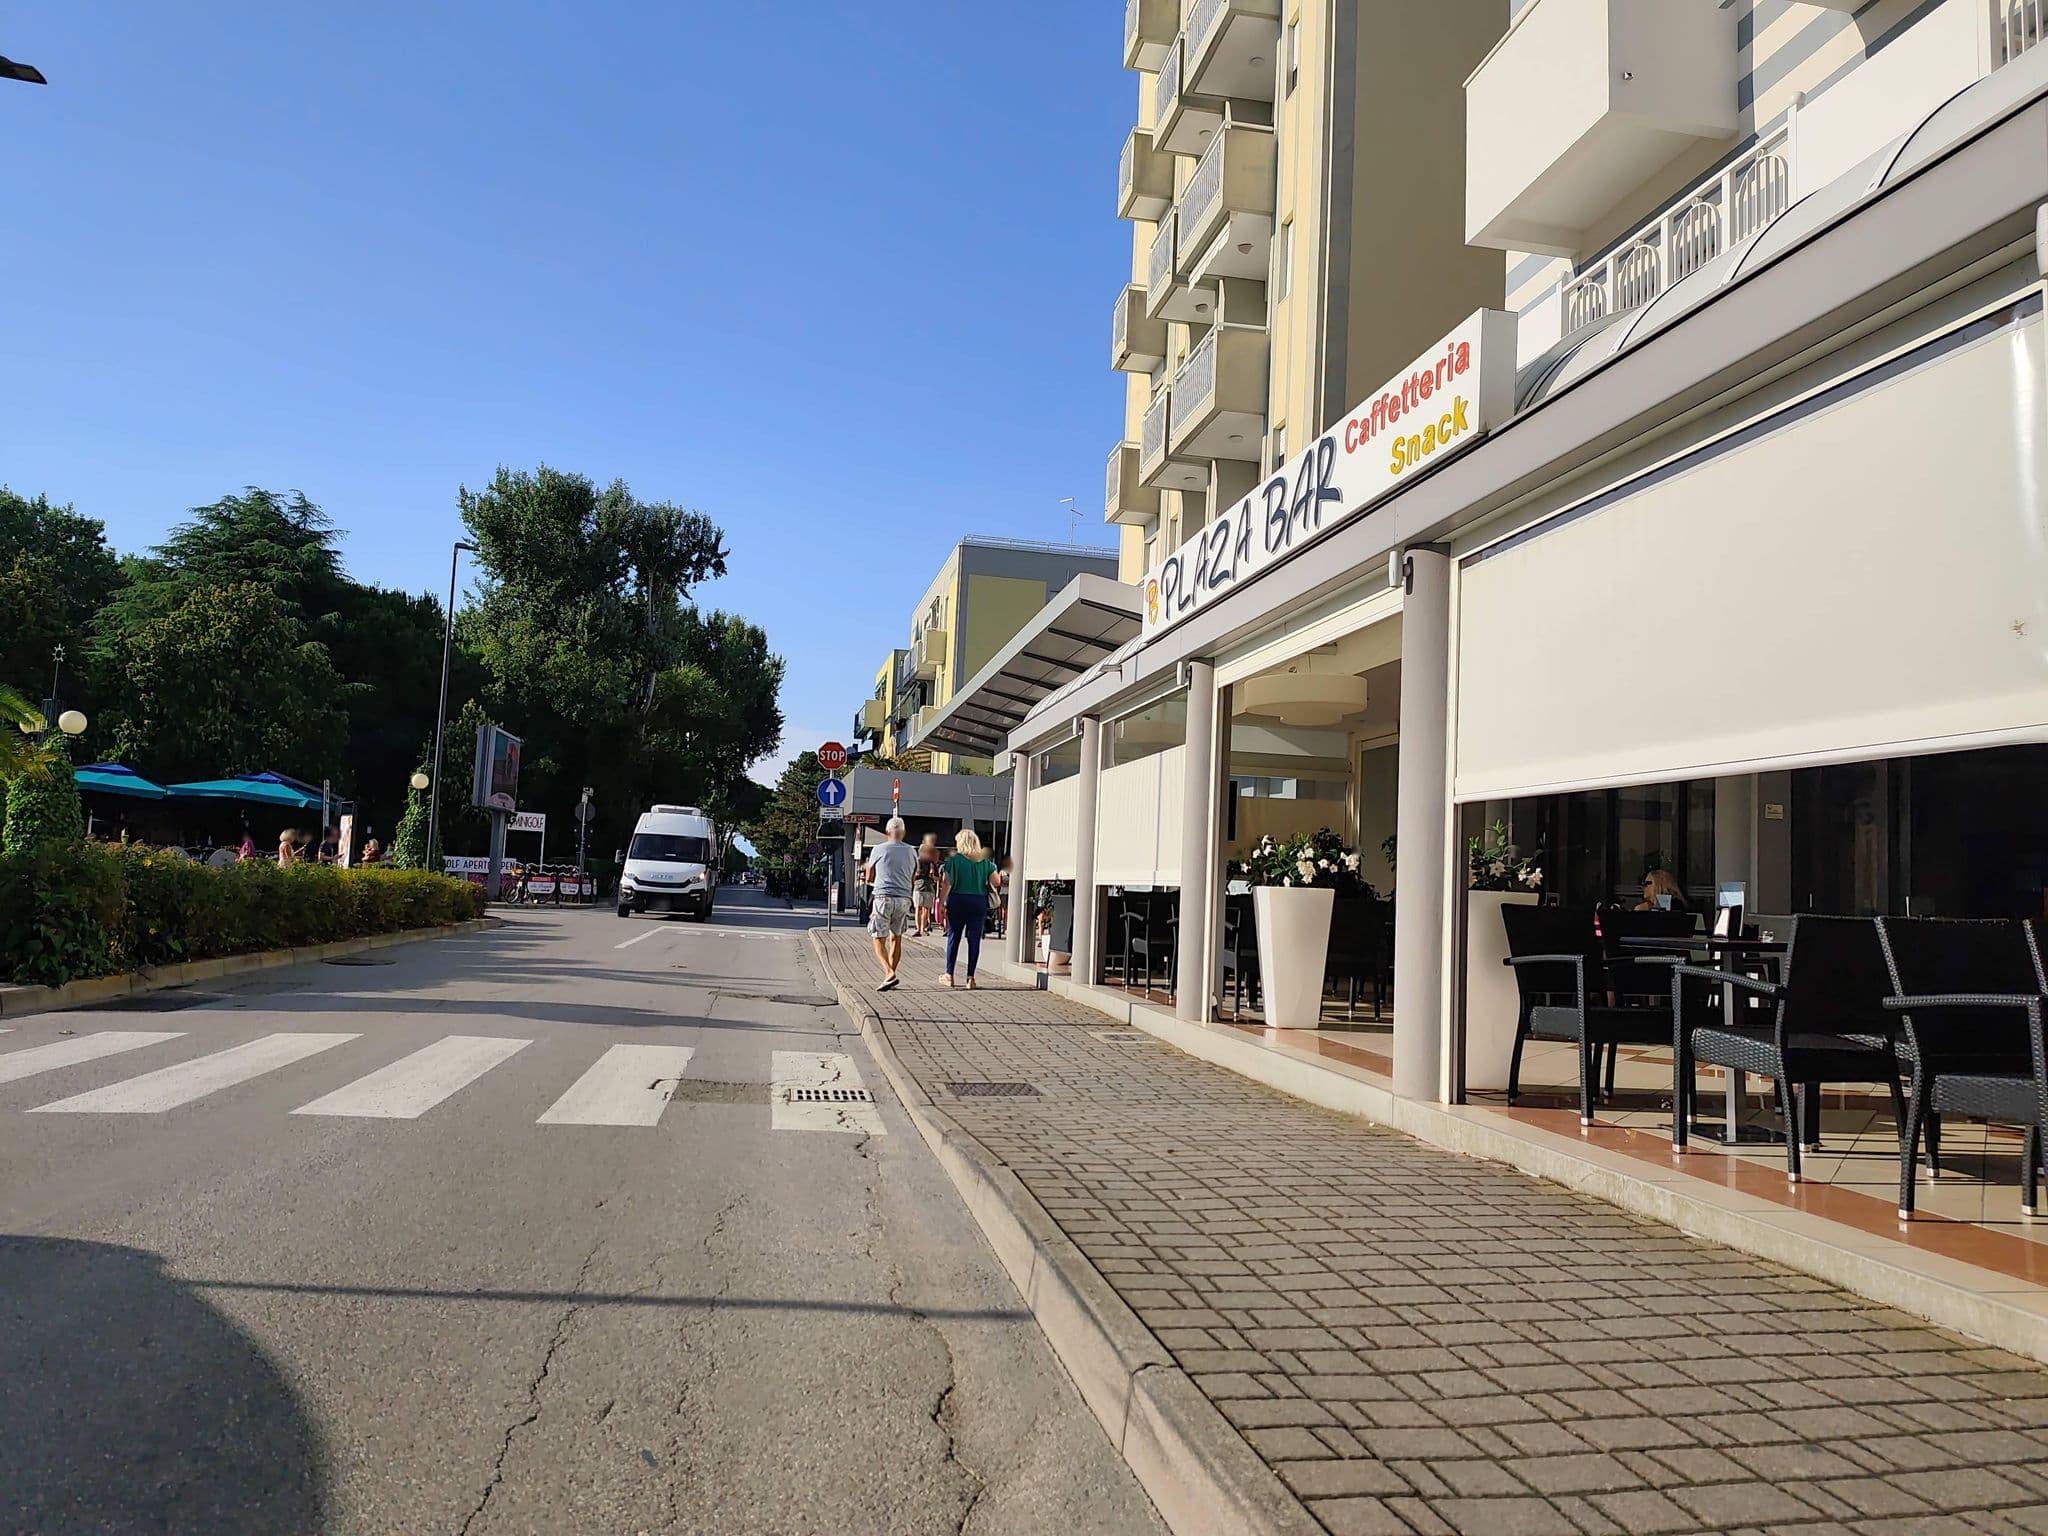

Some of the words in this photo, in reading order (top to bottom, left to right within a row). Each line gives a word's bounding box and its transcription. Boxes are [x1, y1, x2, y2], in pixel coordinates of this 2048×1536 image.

[1345, 341, 1470, 454] Caffetteria
[1390, 395, 1469, 475] Snack
[1160, 497, 1254, 621] PLAZA
[1262, 435, 1344, 554] BAR
[820, 750, 845, 762] STOP
[500, 861, 516, 871] PEN
